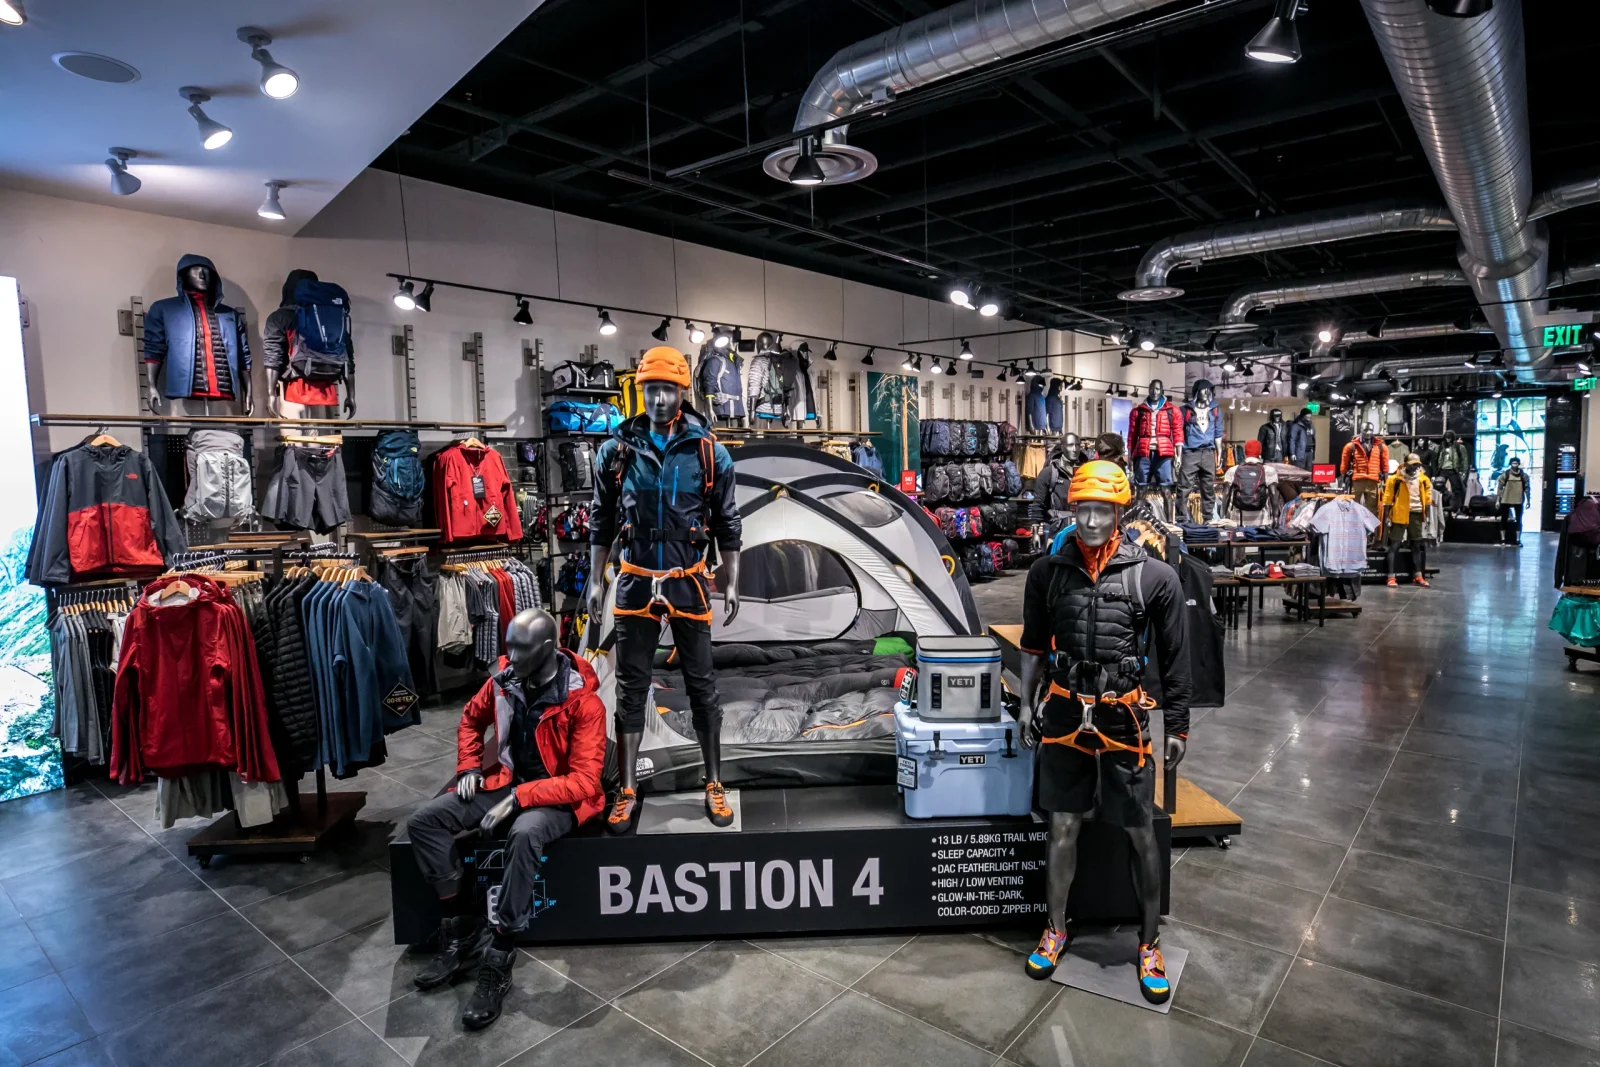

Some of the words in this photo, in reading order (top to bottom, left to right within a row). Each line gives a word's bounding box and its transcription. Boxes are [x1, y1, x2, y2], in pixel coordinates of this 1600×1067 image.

[1543, 325, 1582, 347] EXIT
[1574, 377, 1597, 391] EXIT
[950, 677, 973, 686] YETI
[961, 756, 984, 764] YETI
[938, 835, 949, 845] 13
[951, 835, 962, 844] LB
[964, 834, 969, 844] /
[970, 833, 1001, 844] 5.89KG
[1003, 833, 1027, 842] TRAIL
[1028, 832, 1048, 841] WEI
[937, 849, 965, 859] SLEEP
[966, 848, 1007, 858] CAPACITY
[1009, 848, 1015, 857] 4
[938, 864, 956, 874] DAC
[957, 861, 1020, 873] FEATHERLIGHT
[599, 859, 833, 915] BASTION
[852, 857, 884, 906] 4
[937, 878, 958, 888] HIGH
[960, 878, 964, 887] /
[966, 877, 986, 887] LOW
[987, 876, 1024, 886] VENTING
[937, 890, 1024, 902] GLOW-IN-THE-DARK,
[937, 905, 1000, 917] COLOR-CODED
[1002, 904, 1031, 914] ZIPPER
